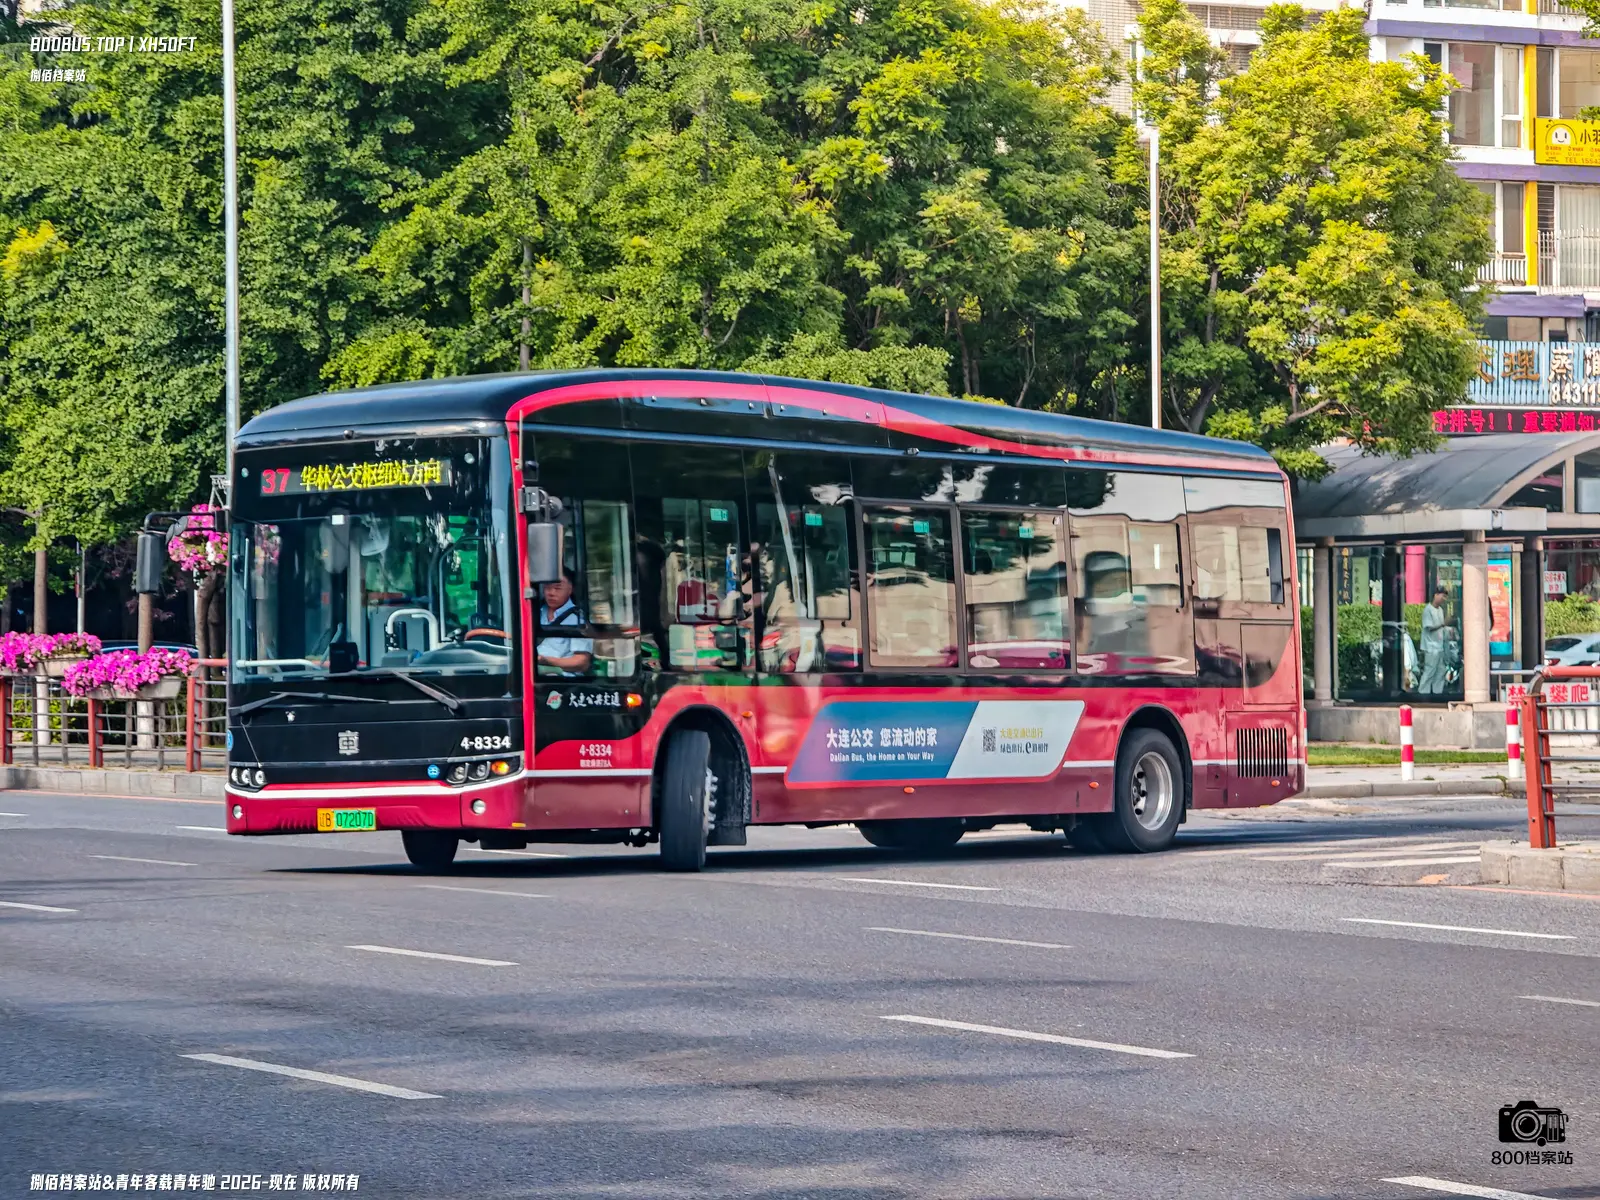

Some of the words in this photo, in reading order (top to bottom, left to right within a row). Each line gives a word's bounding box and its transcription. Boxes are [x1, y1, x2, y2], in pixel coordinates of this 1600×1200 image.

[262, 468, 291, 494] 37
[300, 457, 441, 492] 华林公交枢纽站方向
[568, 691, 622, 708] 大连公共交通
[1508, 684, 1589, 707] 禁攀爬
[460, 735, 511, 750] 4-8334
[826, 727, 874, 749] 大连公交
[880, 726, 938, 748] 您流动的家
[579, 743, 612, 757] 4-8334
[829, 752, 850, 763] Dalian
[866, 751, 877, 762] the
[878, 751, 896, 762] Home
[906, 750, 920, 761] Your
[921, 750, 935, 762] Way
